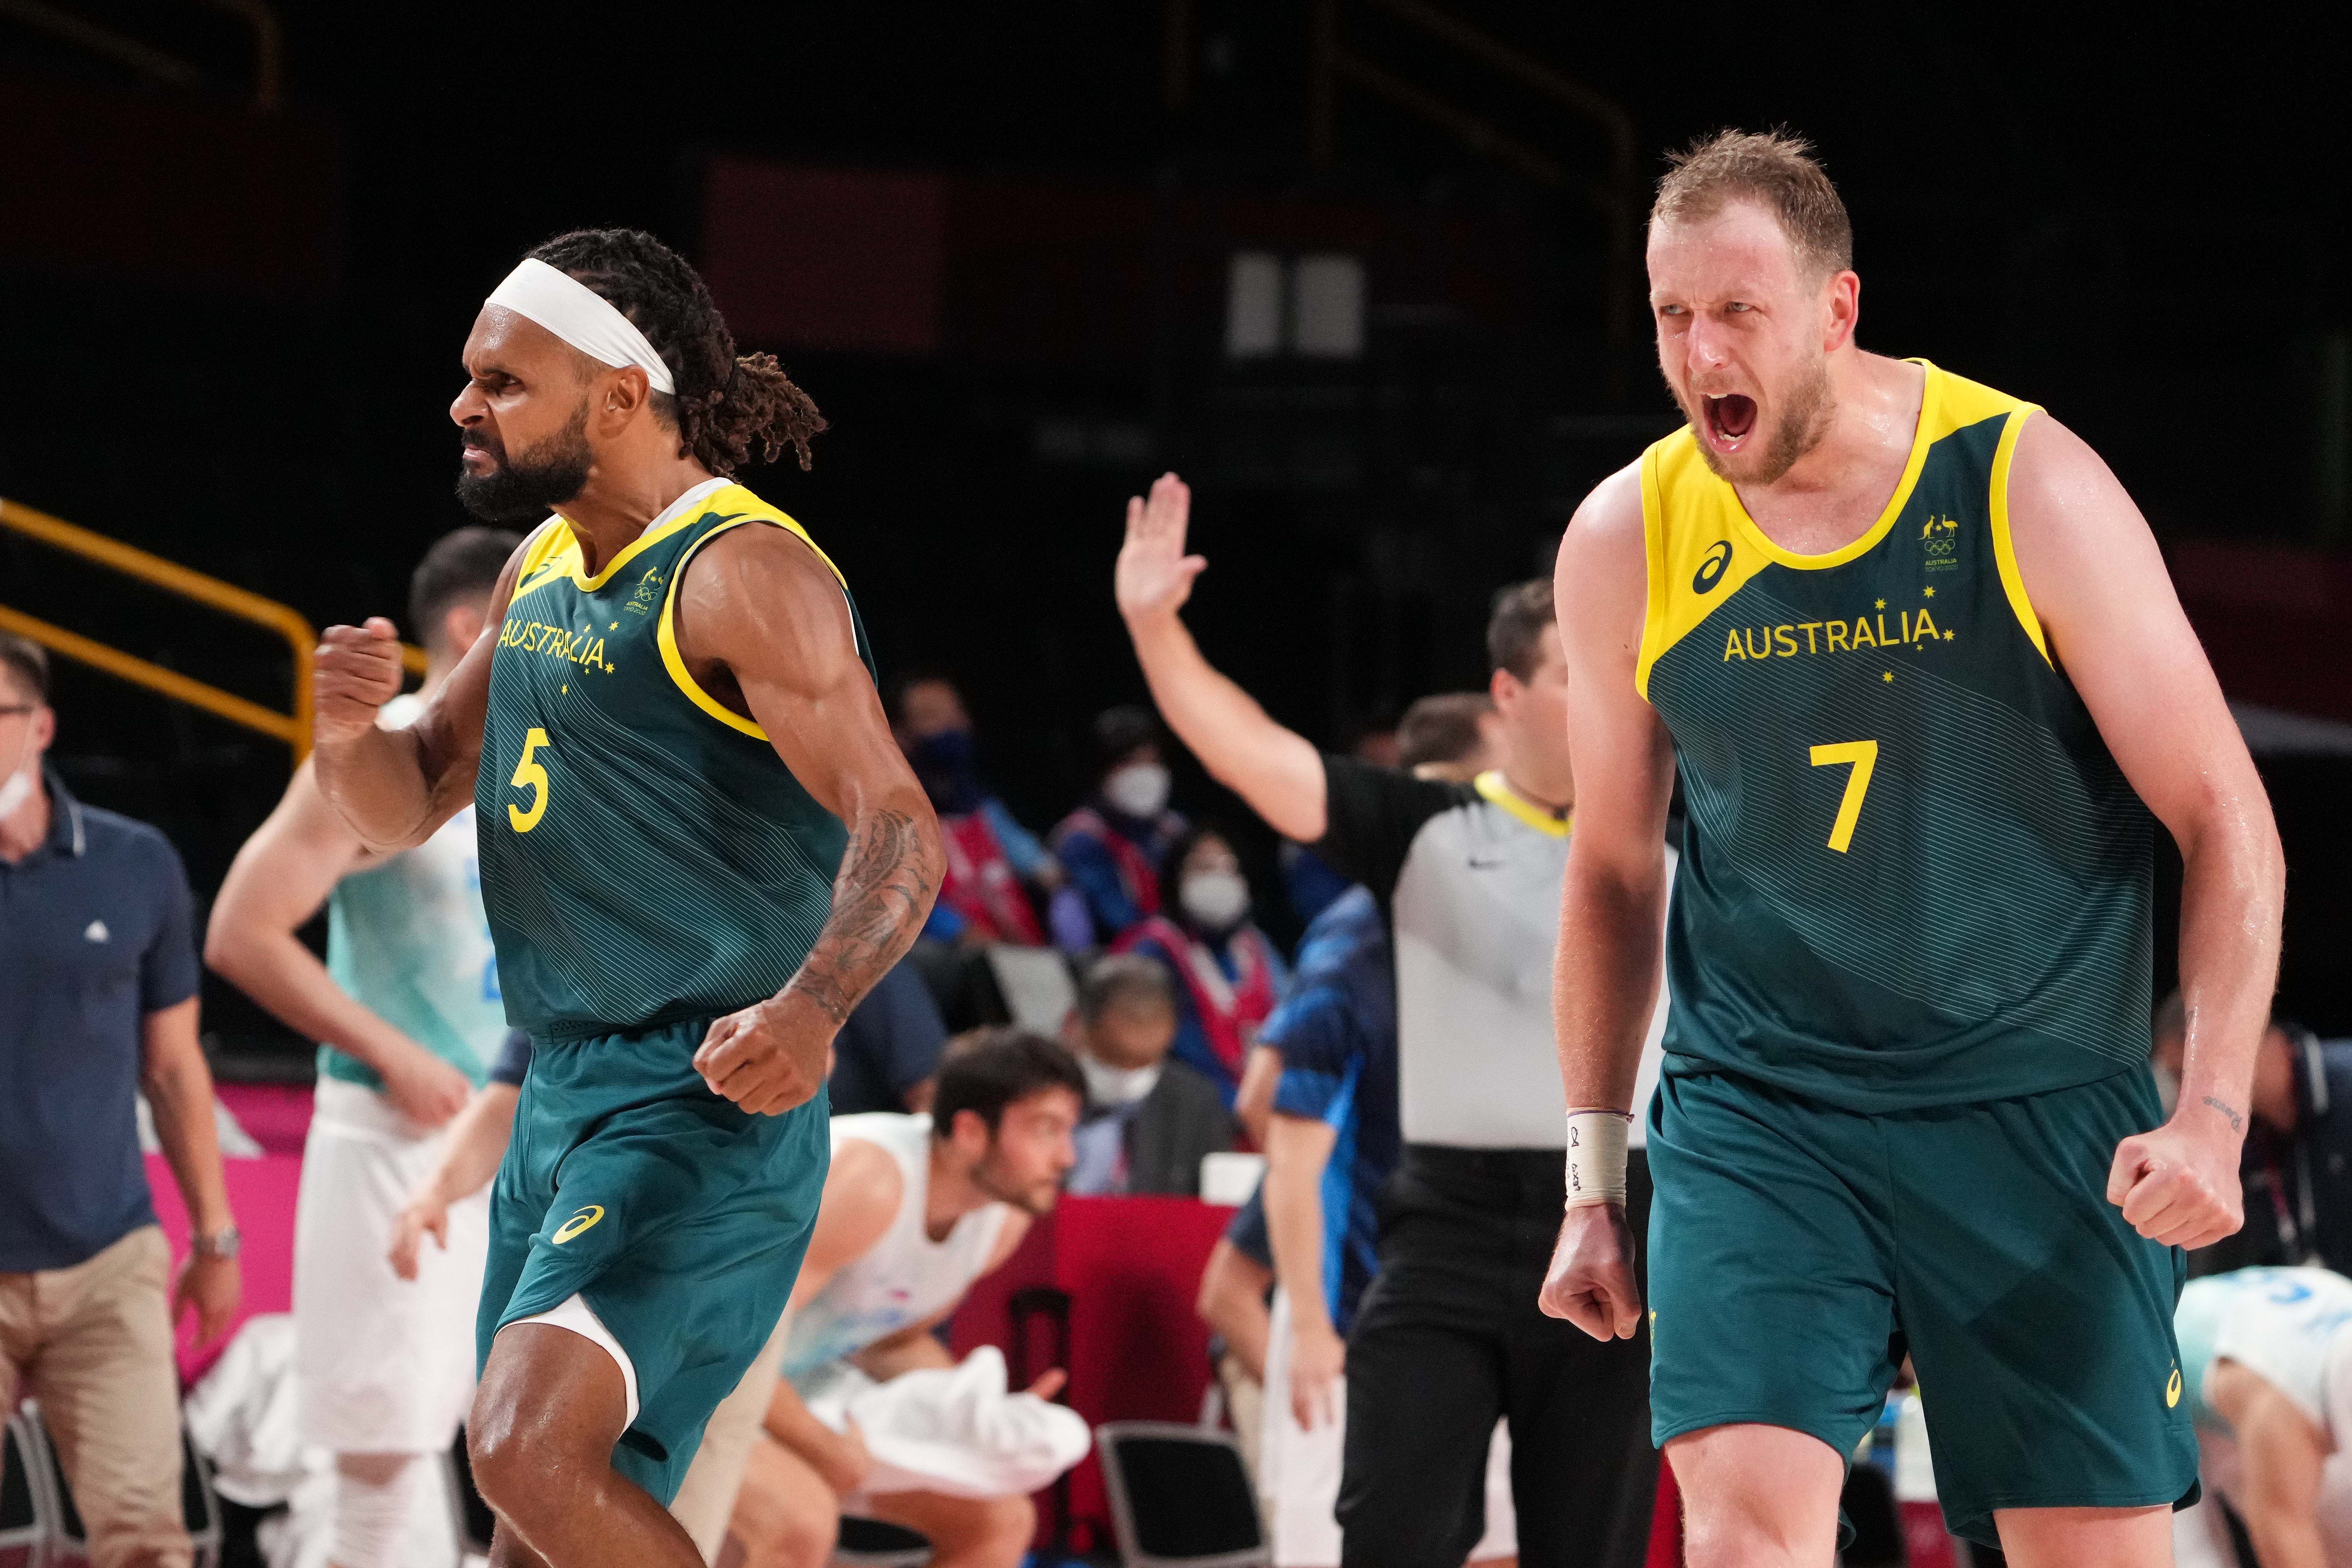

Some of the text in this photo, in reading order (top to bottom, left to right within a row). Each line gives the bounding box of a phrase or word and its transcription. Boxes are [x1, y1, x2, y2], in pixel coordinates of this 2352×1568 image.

[497, 618, 604, 669] AUSTRALIA
[1724, 609, 1940, 661] AUSTRALIA
[508, 728, 550, 832] 5
[1810, 740, 1878, 853] 7
